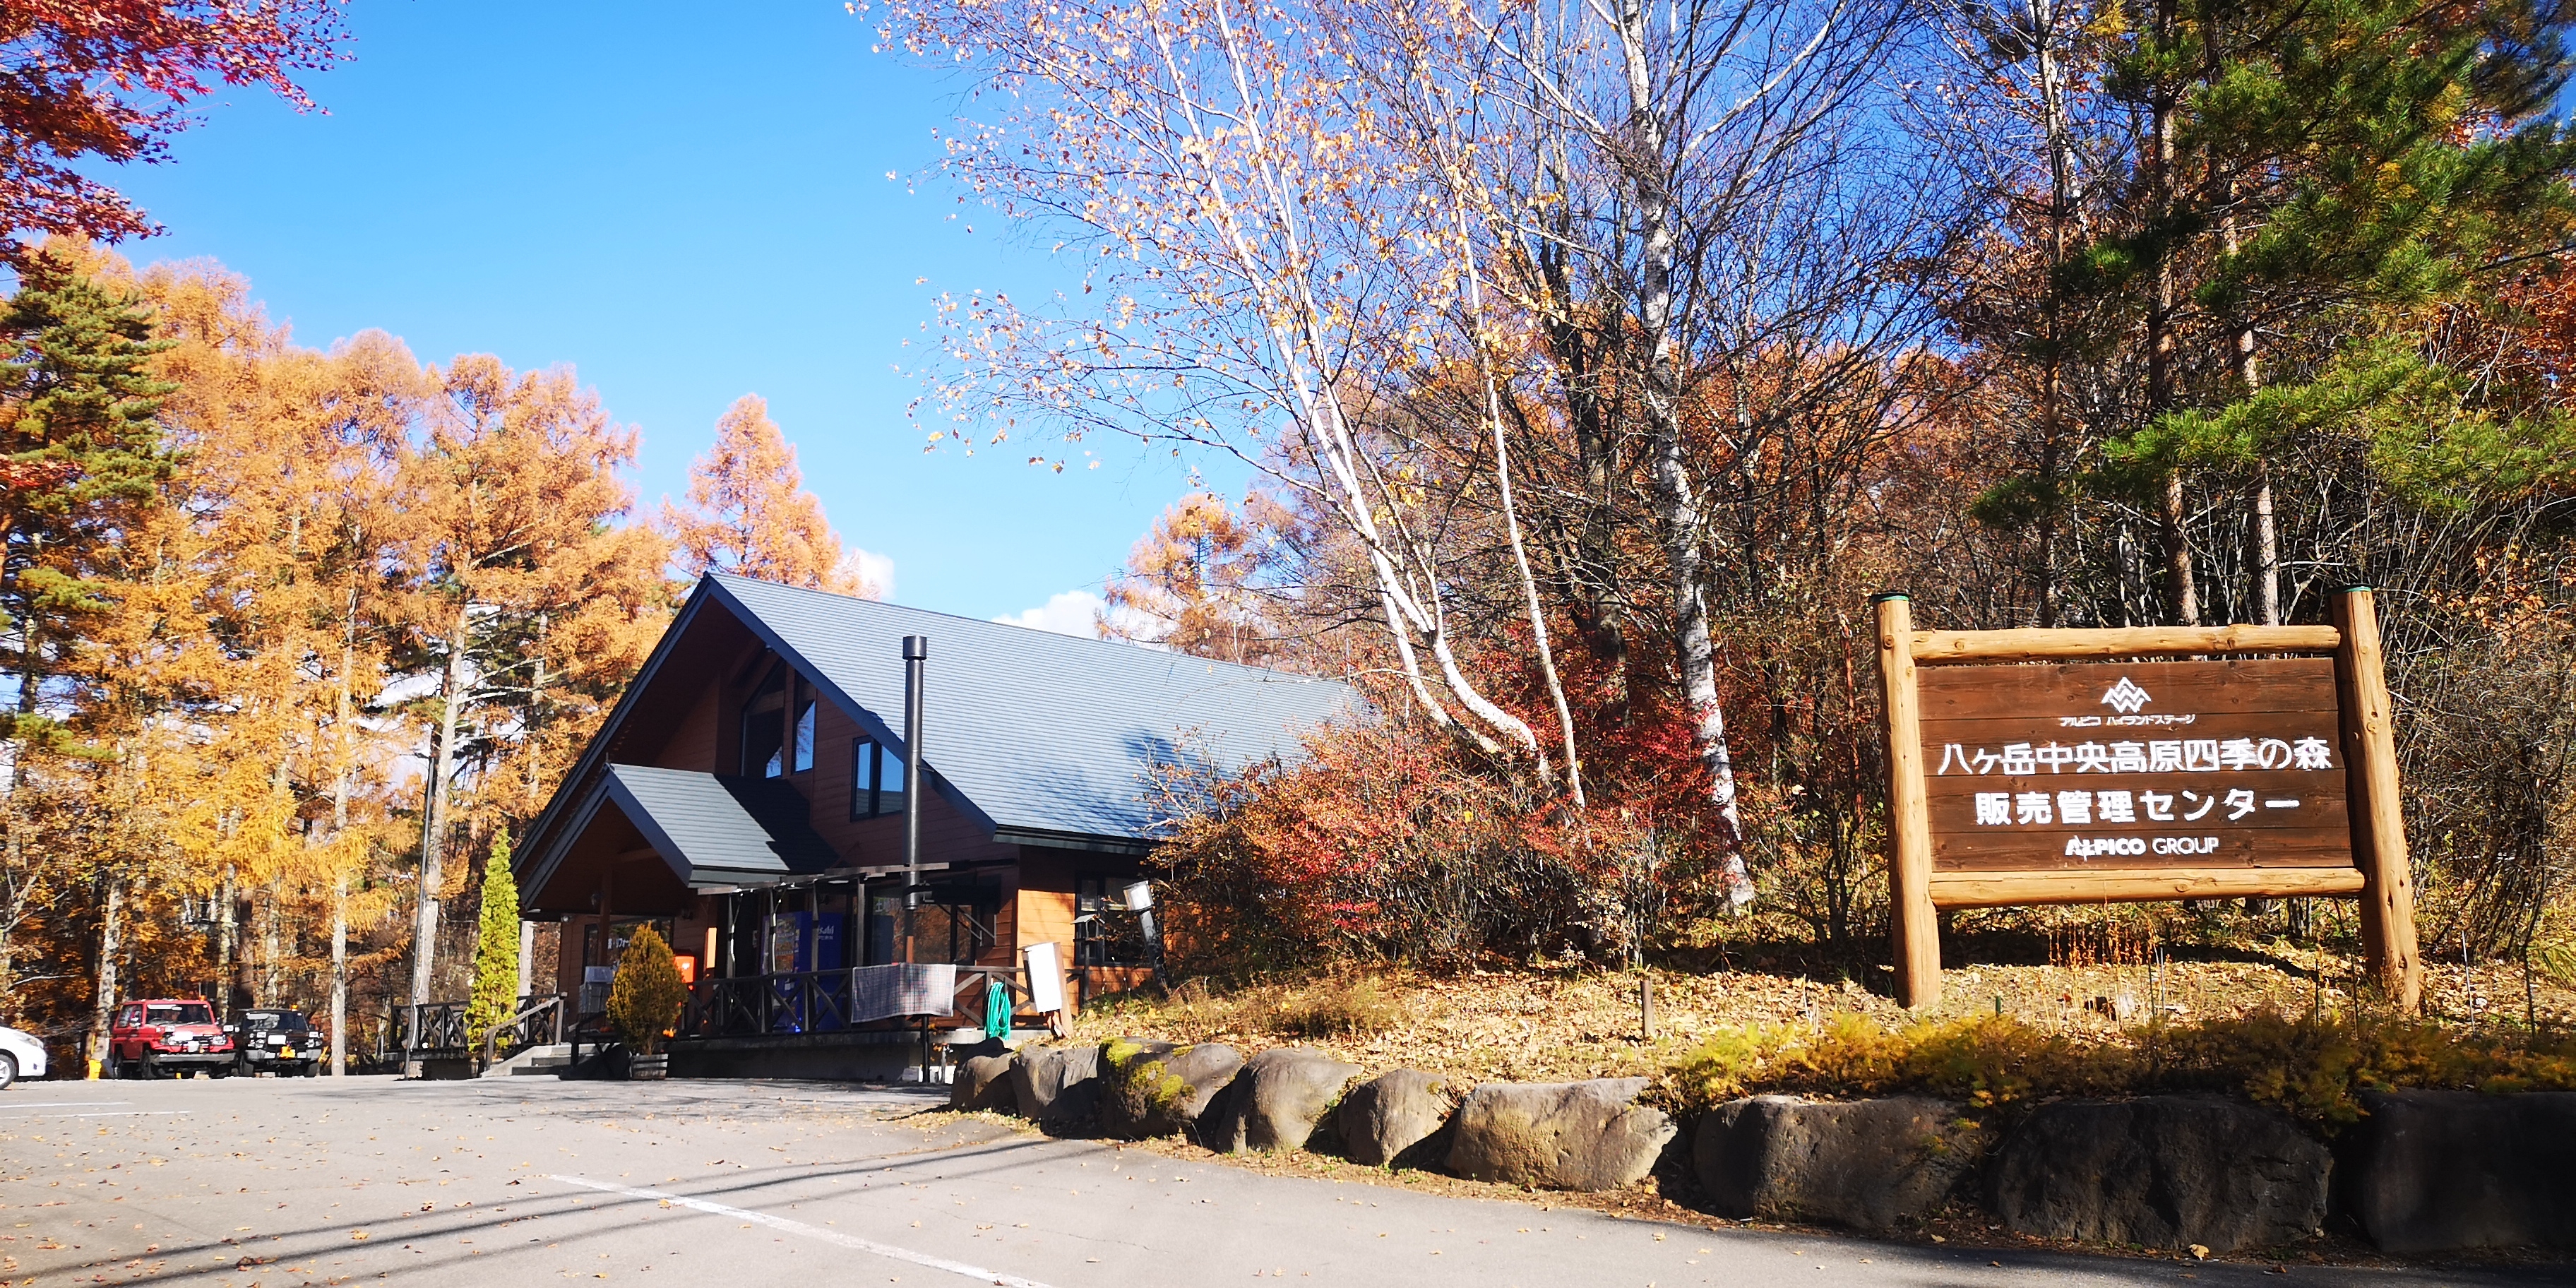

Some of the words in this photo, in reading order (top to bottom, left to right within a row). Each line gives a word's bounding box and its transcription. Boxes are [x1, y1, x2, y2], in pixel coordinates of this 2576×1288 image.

[2060, 715, 2101, 727] アルピコ
[2106, 714, 2195, 726] ハイランドステージ
[1938, 736, 2332, 775] 八ヶ岳中央高原四季の森
[1974, 788, 2301, 825] 販売管理センター
[2065, 835, 2147, 861] ALPICO
[2152, 837, 2219, 855] GROUP
